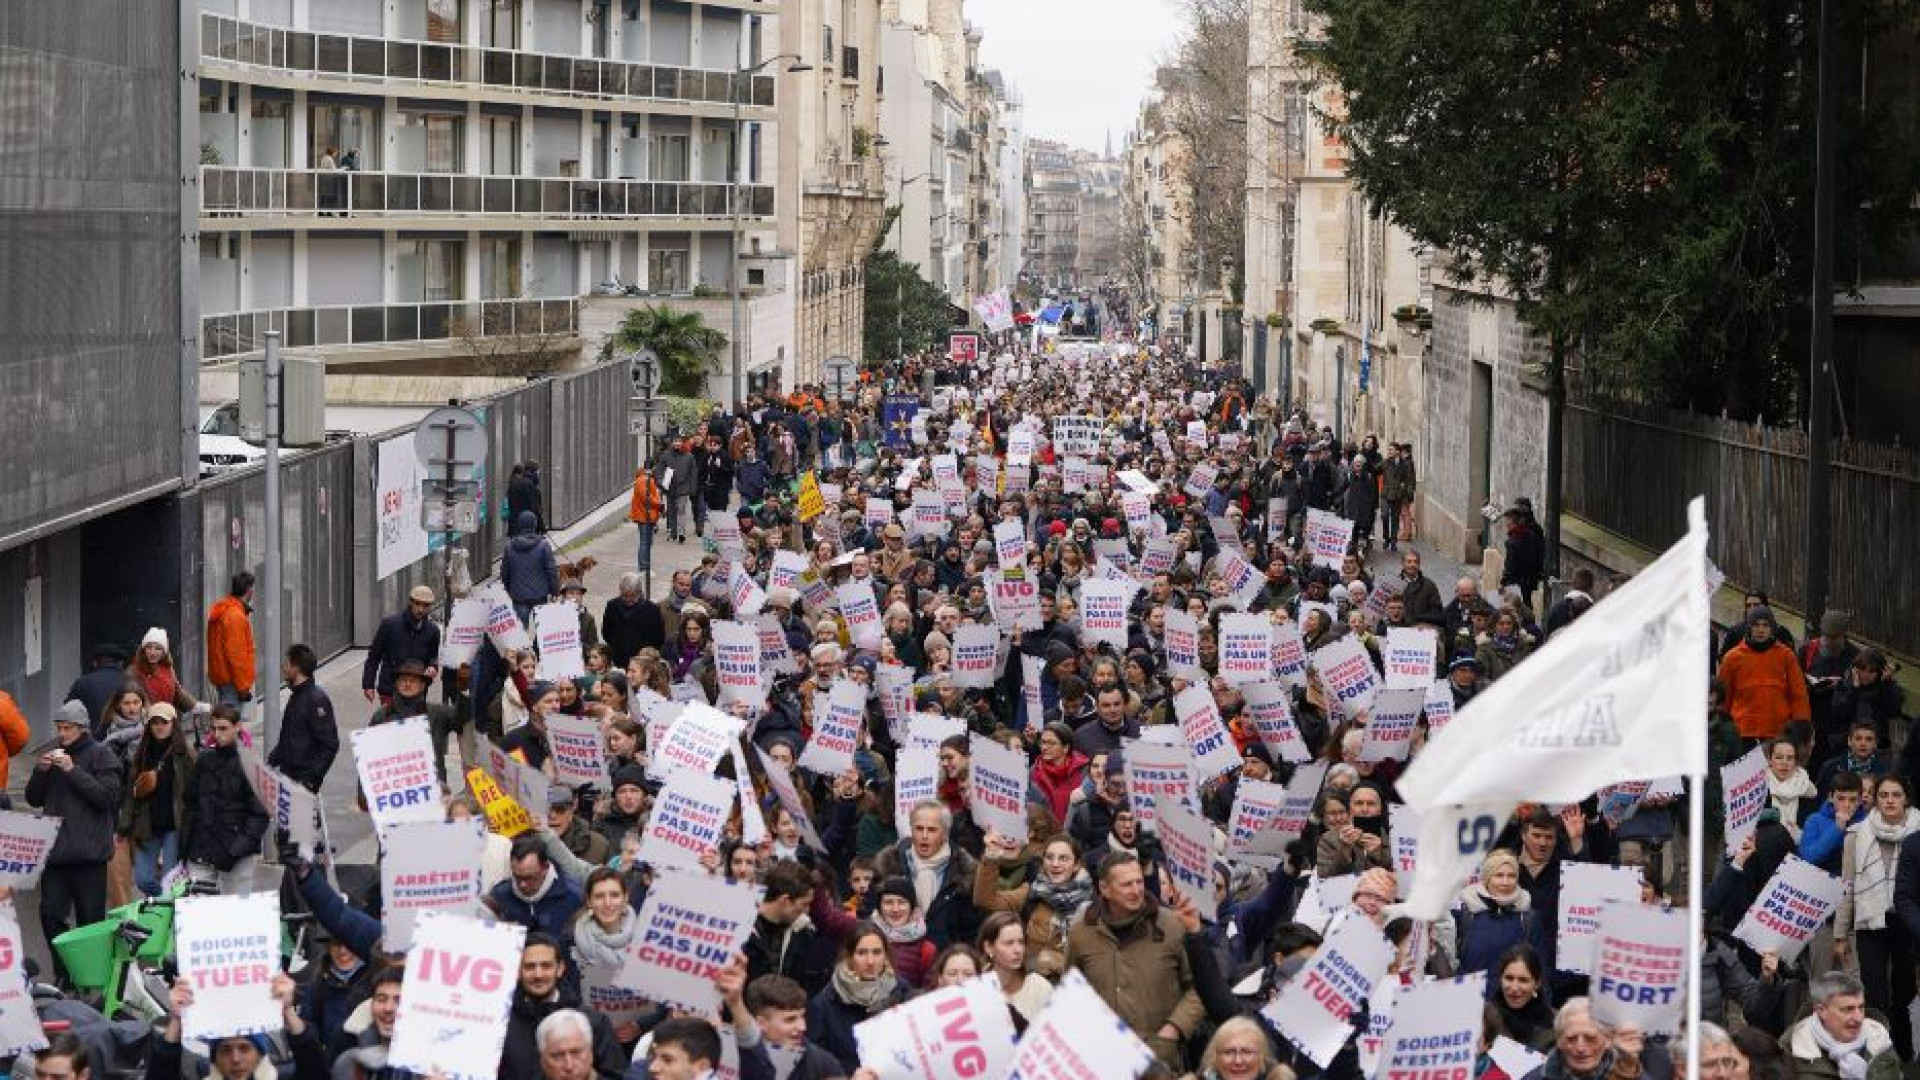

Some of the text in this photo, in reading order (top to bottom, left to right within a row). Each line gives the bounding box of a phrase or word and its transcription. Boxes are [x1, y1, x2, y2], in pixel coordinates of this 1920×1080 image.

[996, 582, 1034, 598] IVG
[1086, 620, 1123, 629] CHOIX
[1225, 660, 1267, 671] CHOIX
[1391, 663, 1429, 675] TUER
[1337, 676, 1376, 703] FORT
[821, 723, 845, 738] PAS
[1196, 731, 1225, 756] ORT
[1371, 730, 1411, 742] TUER
[555, 744, 598, 758] MORT
[664, 744, 711, 771] CHOIX
[1170, 769, 1189, 781] LA
[376, 785, 432, 812] FORT
[663, 801, 681, 814] UN
[667, 790, 703, 809] VIVRE
[976, 787, 1021, 815] TUER
[658, 812, 715, 840] PAS UN
[653, 827, 711, 856] CHOIX
[394, 868, 471, 886] ARRÊTER
[1168, 857, 1207, 890] ORT
[657, 902, 740, 933] VIVRE EST
[1755, 911, 1809, 941] CHOIX
[1763, 899, 1818, 929] PAS UN
[190, 935, 268, 953] SOIGNER
[651, 915, 734, 947] UN DROIT
[239, 949, 269, 962] PAS
[644, 930, 729, 964] PAS UN
[192, 963, 271, 990] TUER
[418, 946, 504, 993] IVG
[638, 946, 723, 981] CHOIX
[1326, 949, 1372, 992] SOIGNER
[1302, 971, 1353, 1023] TUER
[1599, 976, 1676, 1005] FORT
[935, 996, 987, 1078] IVG
[1395, 1030, 1473, 1052] SOIGNER
[1391, 1048, 1472, 1067] N'EST PAS
